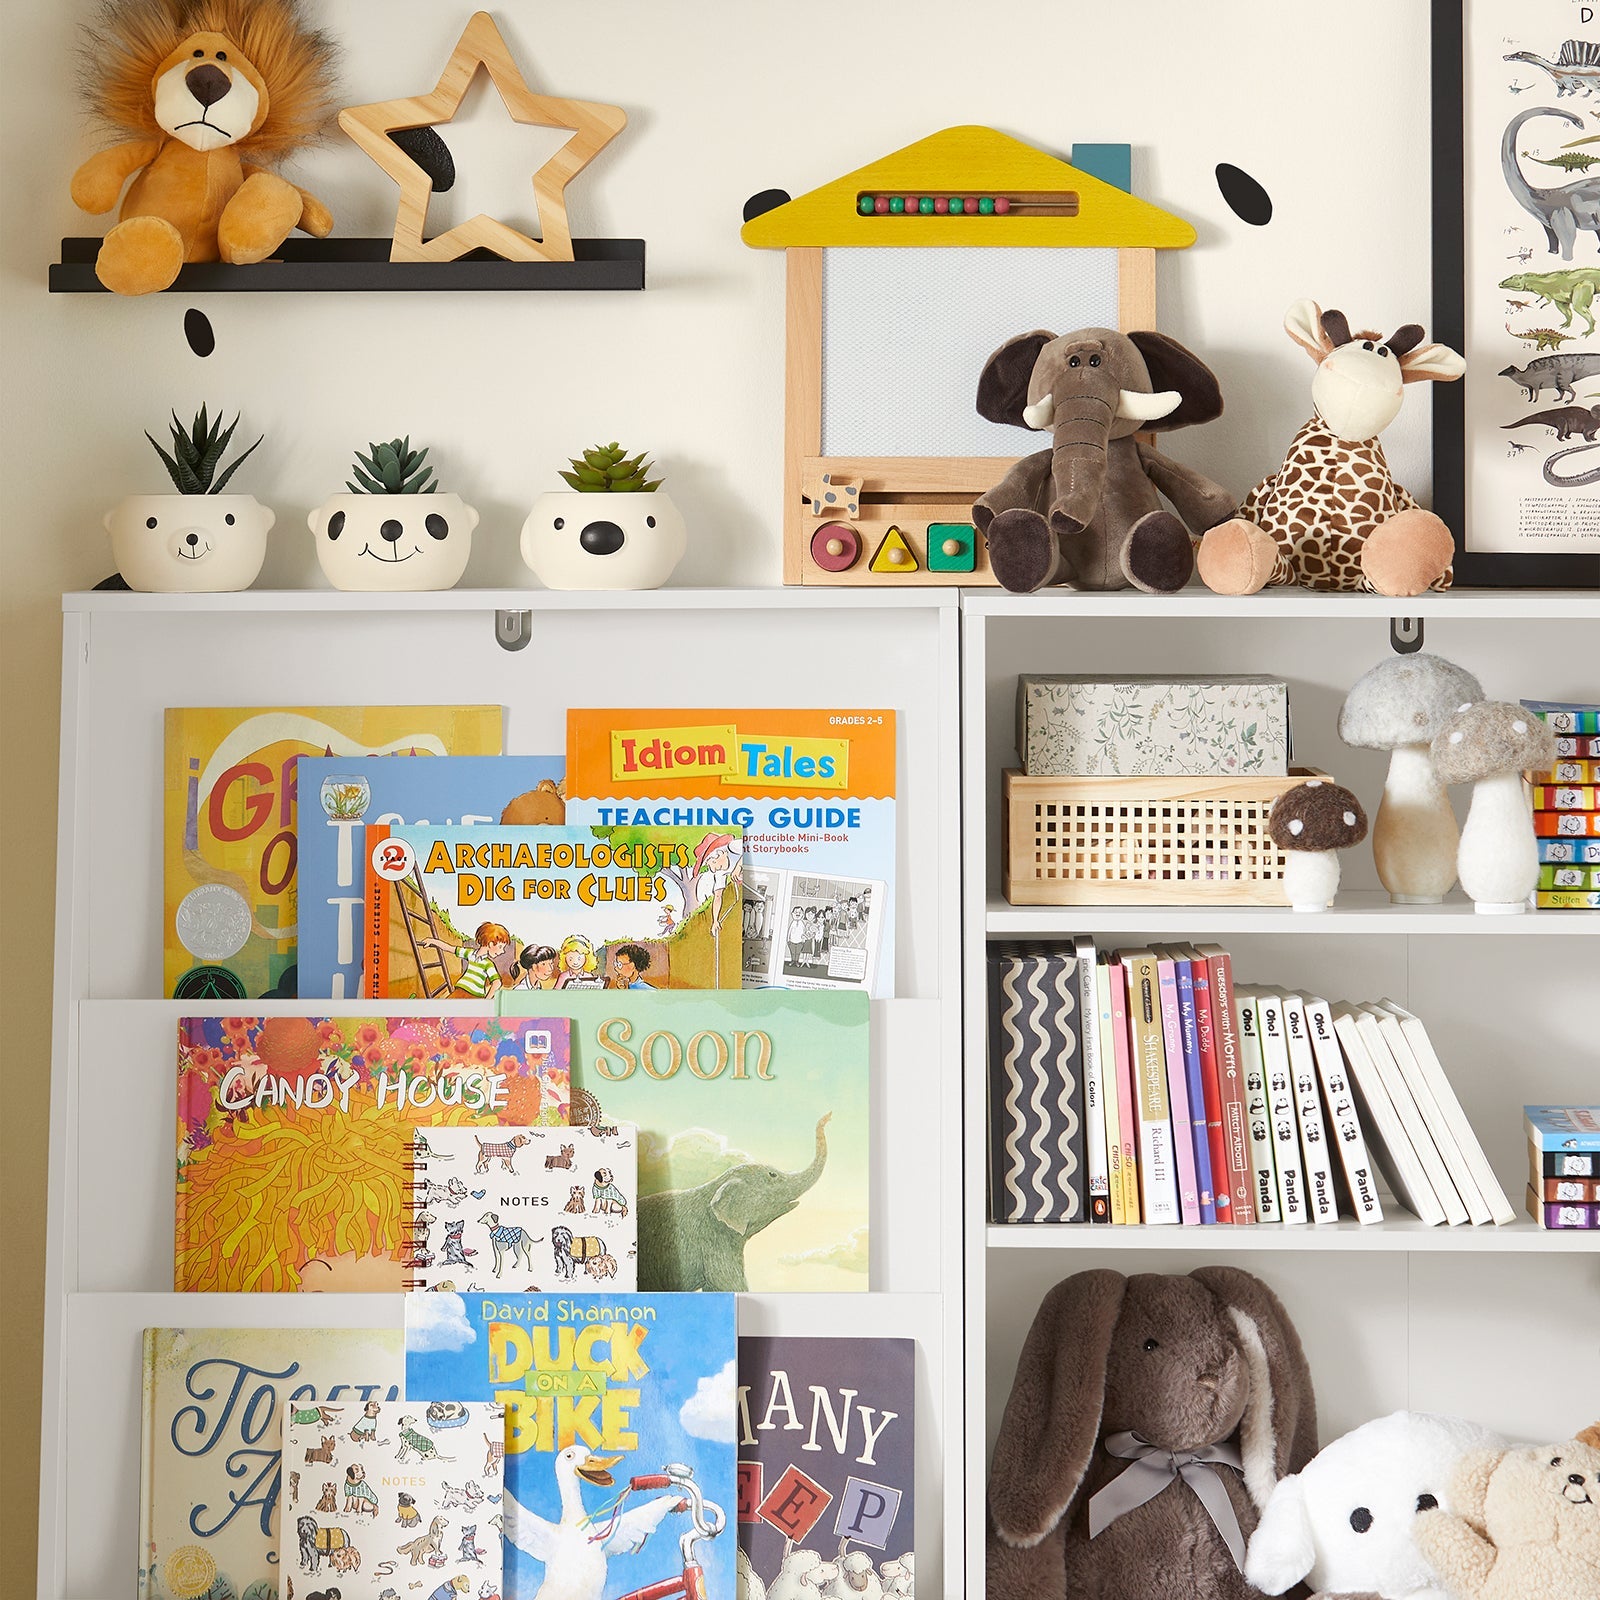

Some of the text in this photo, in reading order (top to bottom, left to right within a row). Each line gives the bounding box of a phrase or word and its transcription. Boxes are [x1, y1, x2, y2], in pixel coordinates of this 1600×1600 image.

[829, 716, 865, 725] GRADES
[621, 738, 835, 778] Idiom Tales
[598, 807, 861, 828] TEACHING GUIDE
[752, 844, 809, 854] Storybooks
[798, 833, 849, 842] Mini-Book
[382, 845, 405, 871] 2
[424, 840, 689, 874] ARCHAEOLOGISTS
[457, 873, 667, 907] DIG FOR CLUES
[1082, 958, 1091, 997] Eric Carle
[1165, 1003, 1177, 1054] My Granny
[1181, 1001, 1194, 1054] My Mummy
[1197, 1009, 1210, 1053] My Daddy
[1217, 967, 1237, 1079] tuesdays with Morrie
[1242, 1008, 1256, 1037] Oho!
[1266, 1008, 1279, 1037] Oho!
[1289, 1011, 1303, 1039] Oho!
[1314, 1012, 1330, 1040] Oho!
[1087, 1053, 1095, 1070] Book
[1143, 1034, 1161, 1112] SHAKESPEARE
[219, 1066, 511, 1114] CANDY HOUSE
[1088, 1081, 1096, 1108] Colors
[1152, 1127, 1165, 1181] Richard III
[1230, 1107, 1243, 1167] Mitch Albom
[500, 1196, 549, 1207] NOTES
[1258, 1169, 1272, 1213] Panda
[1284, 1169, 1299, 1213] Panda
[1314, 1171, 1330, 1215] Panda
[1355, 1168, 1374, 1212] Panda
[482, 1300, 657, 1321] David Shannon
[488, 1322, 650, 1383] DUCK
[537, 1373, 598, 1391] ON A
[494, 1389, 642, 1454] BIKE
[382, 1476, 427, 1486] NOTES
